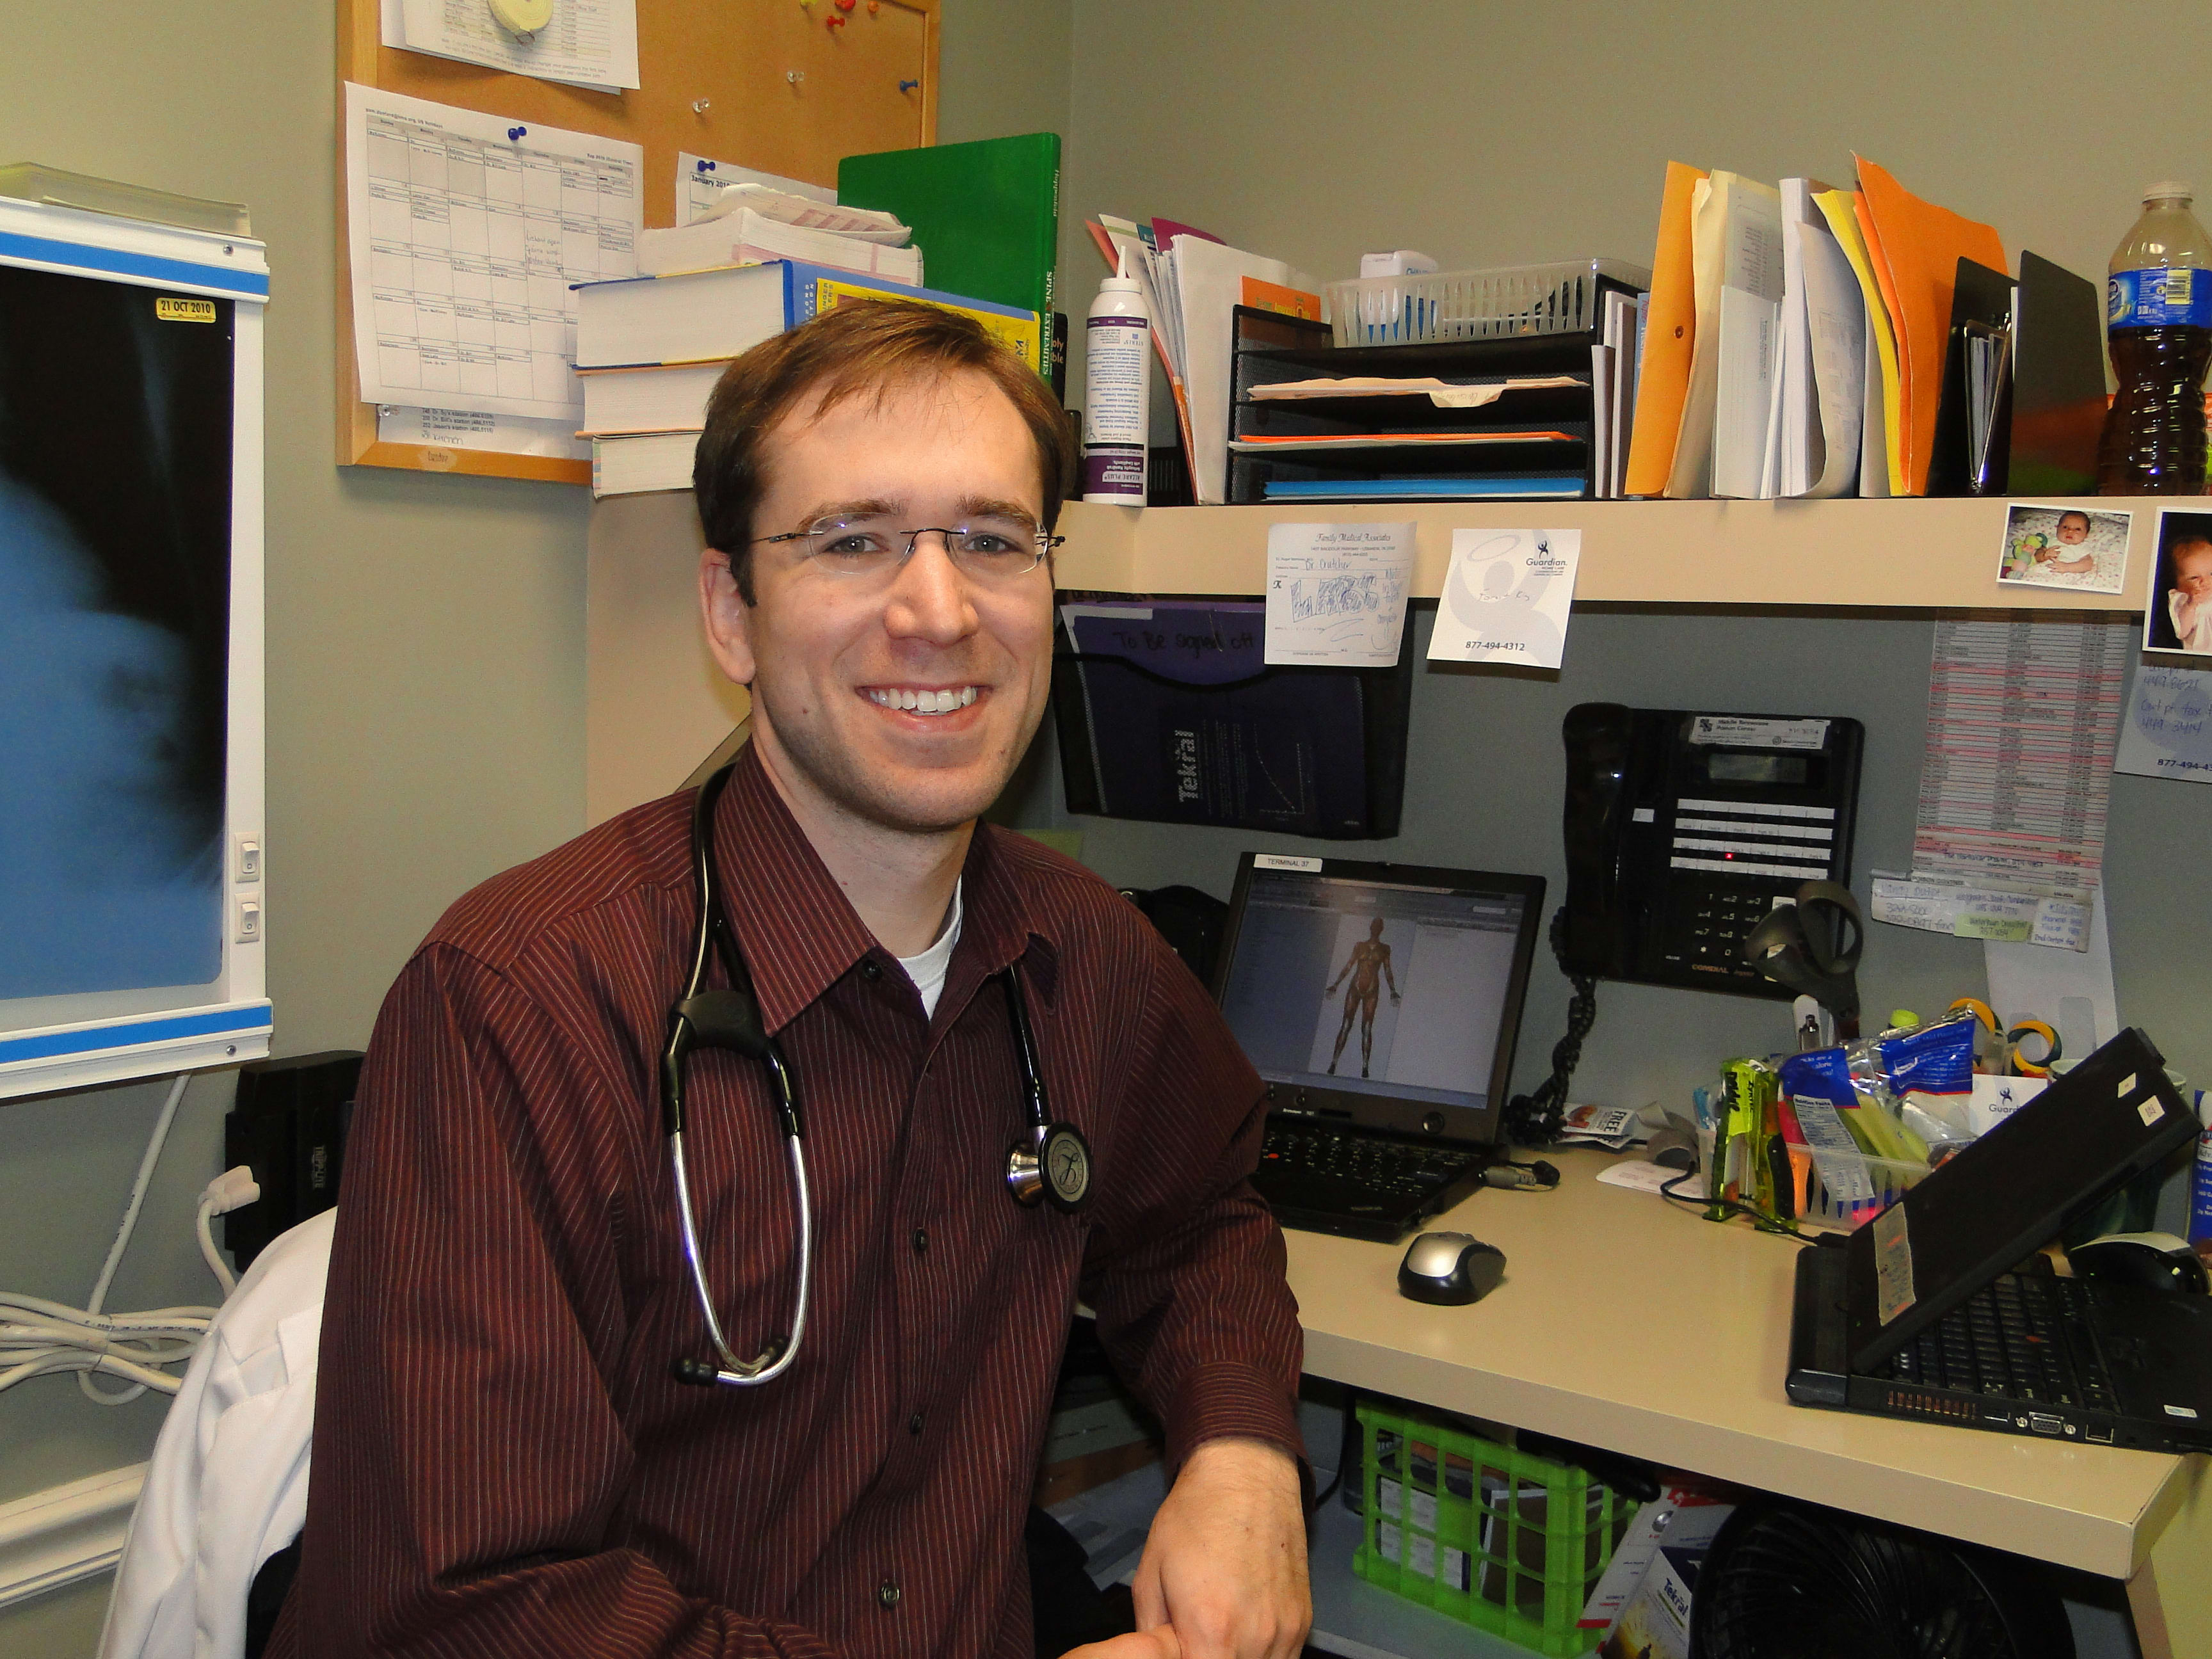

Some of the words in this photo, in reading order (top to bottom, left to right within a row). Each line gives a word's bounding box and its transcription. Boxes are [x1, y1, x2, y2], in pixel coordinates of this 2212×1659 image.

[691, 175, 714, 186] January
[161, 300, 170, 311] 21
[173, 301, 189, 312] OCT
[191, 302, 211, 314] 2010
[1043, 313, 1051, 375] EXTREMITIES
[1052, 337, 1064, 351] oly
[1051, 353, 1064, 364] ble
[1315, 533, 1337, 544] Family
[1338, 533, 1361, 542] Medical
[1362, 533, 1391, 543] Associates
[1526, 557, 1566, 566] Guardian
[1465, 641, 1525, 652] 877-494-4312
[1268, 858, 1300, 867] TERMINAL
[1603, 1110, 1628, 1132] FREE
